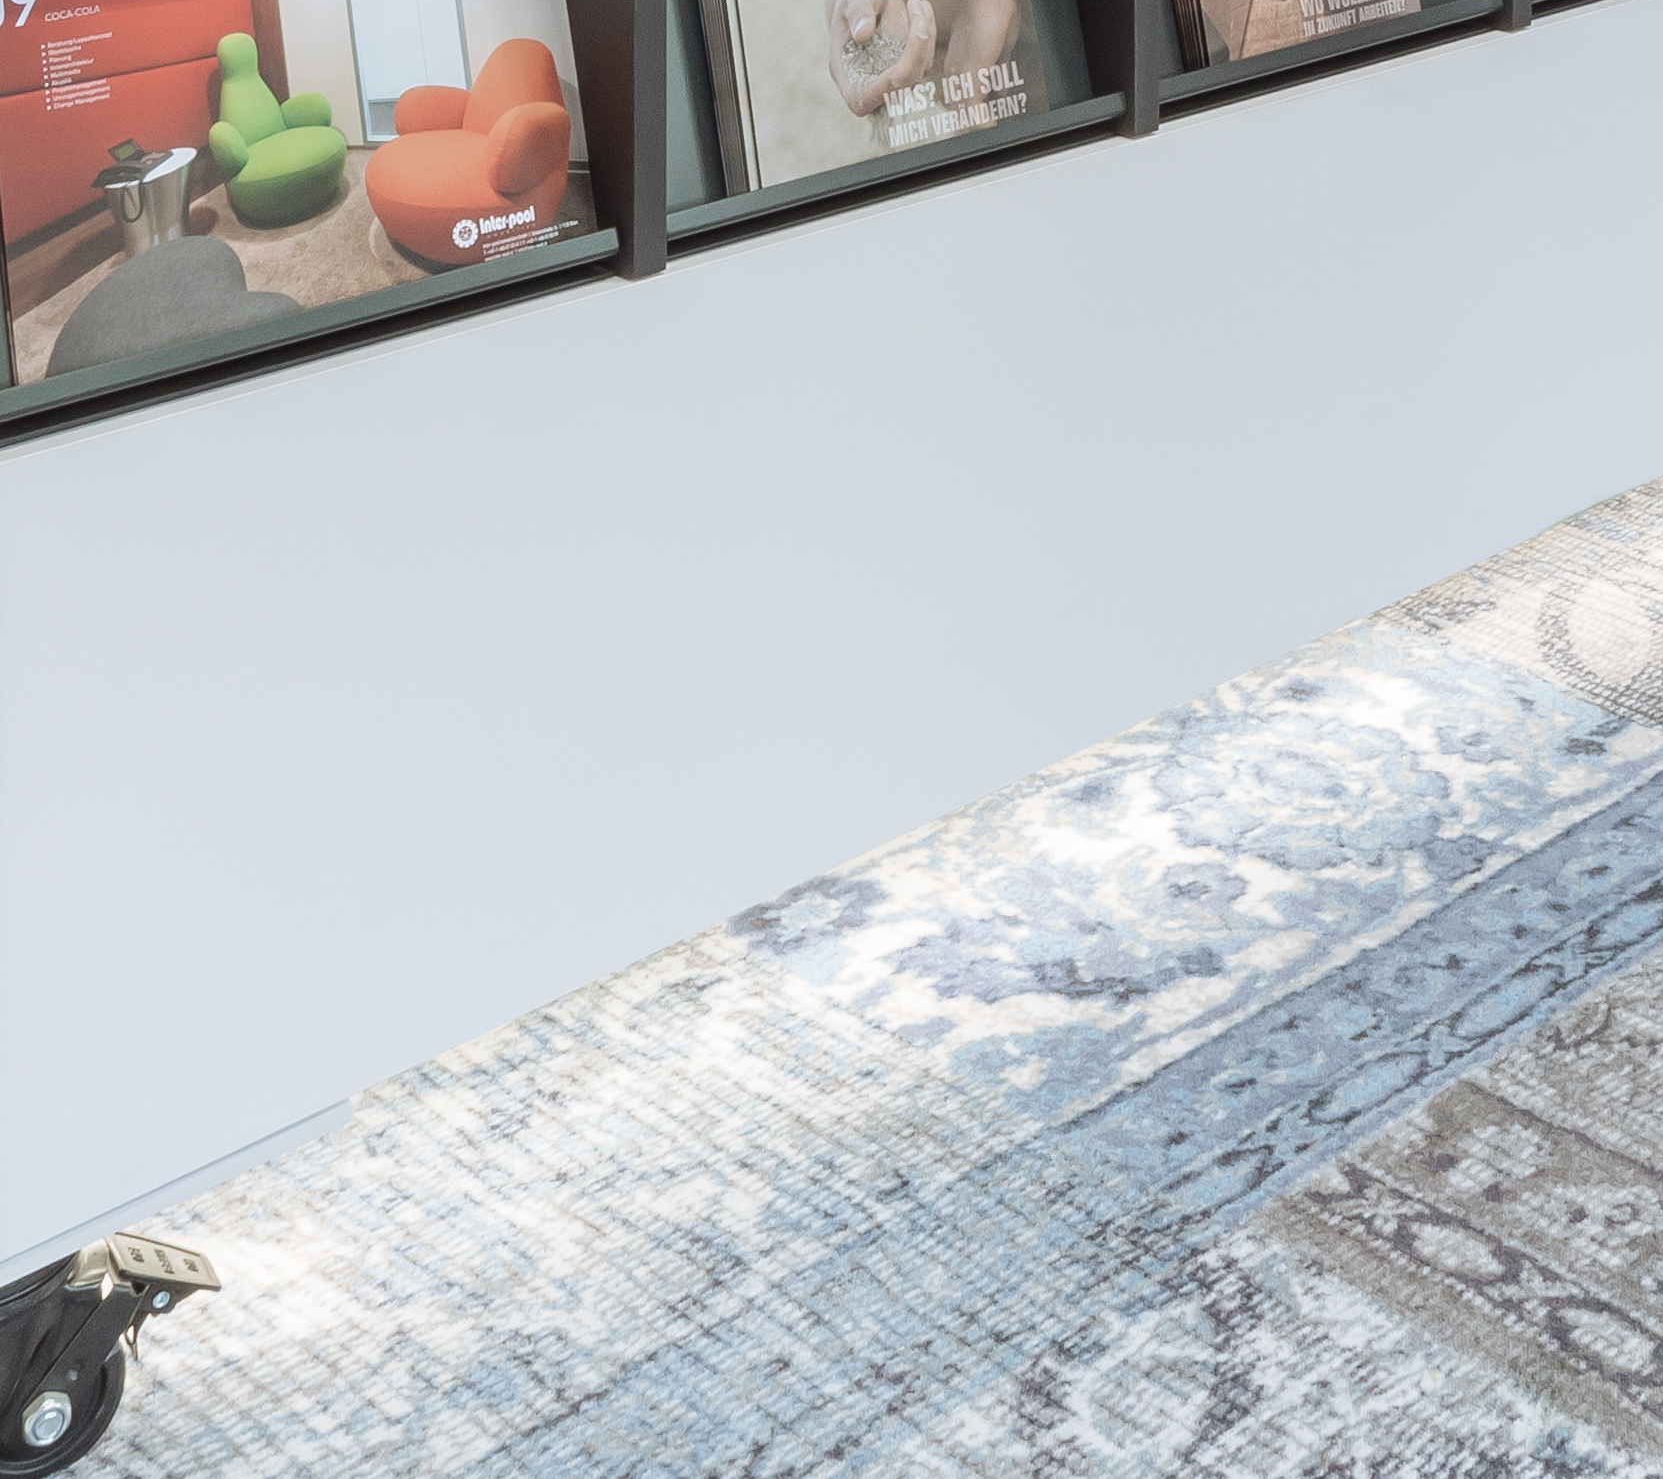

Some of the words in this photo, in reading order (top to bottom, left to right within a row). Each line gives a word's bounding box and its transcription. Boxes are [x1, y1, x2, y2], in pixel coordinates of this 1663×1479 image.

[1316, 9, 1357, 33] ZUKUNFT
[883, 81, 936, 118] WAS?
[942, 72, 975, 104] ICH
[978, 61, 1025, 95] SOLL
[888, 118, 929, 148] MICH
[931, 92, 1027, 136] VERÄNDERN?
